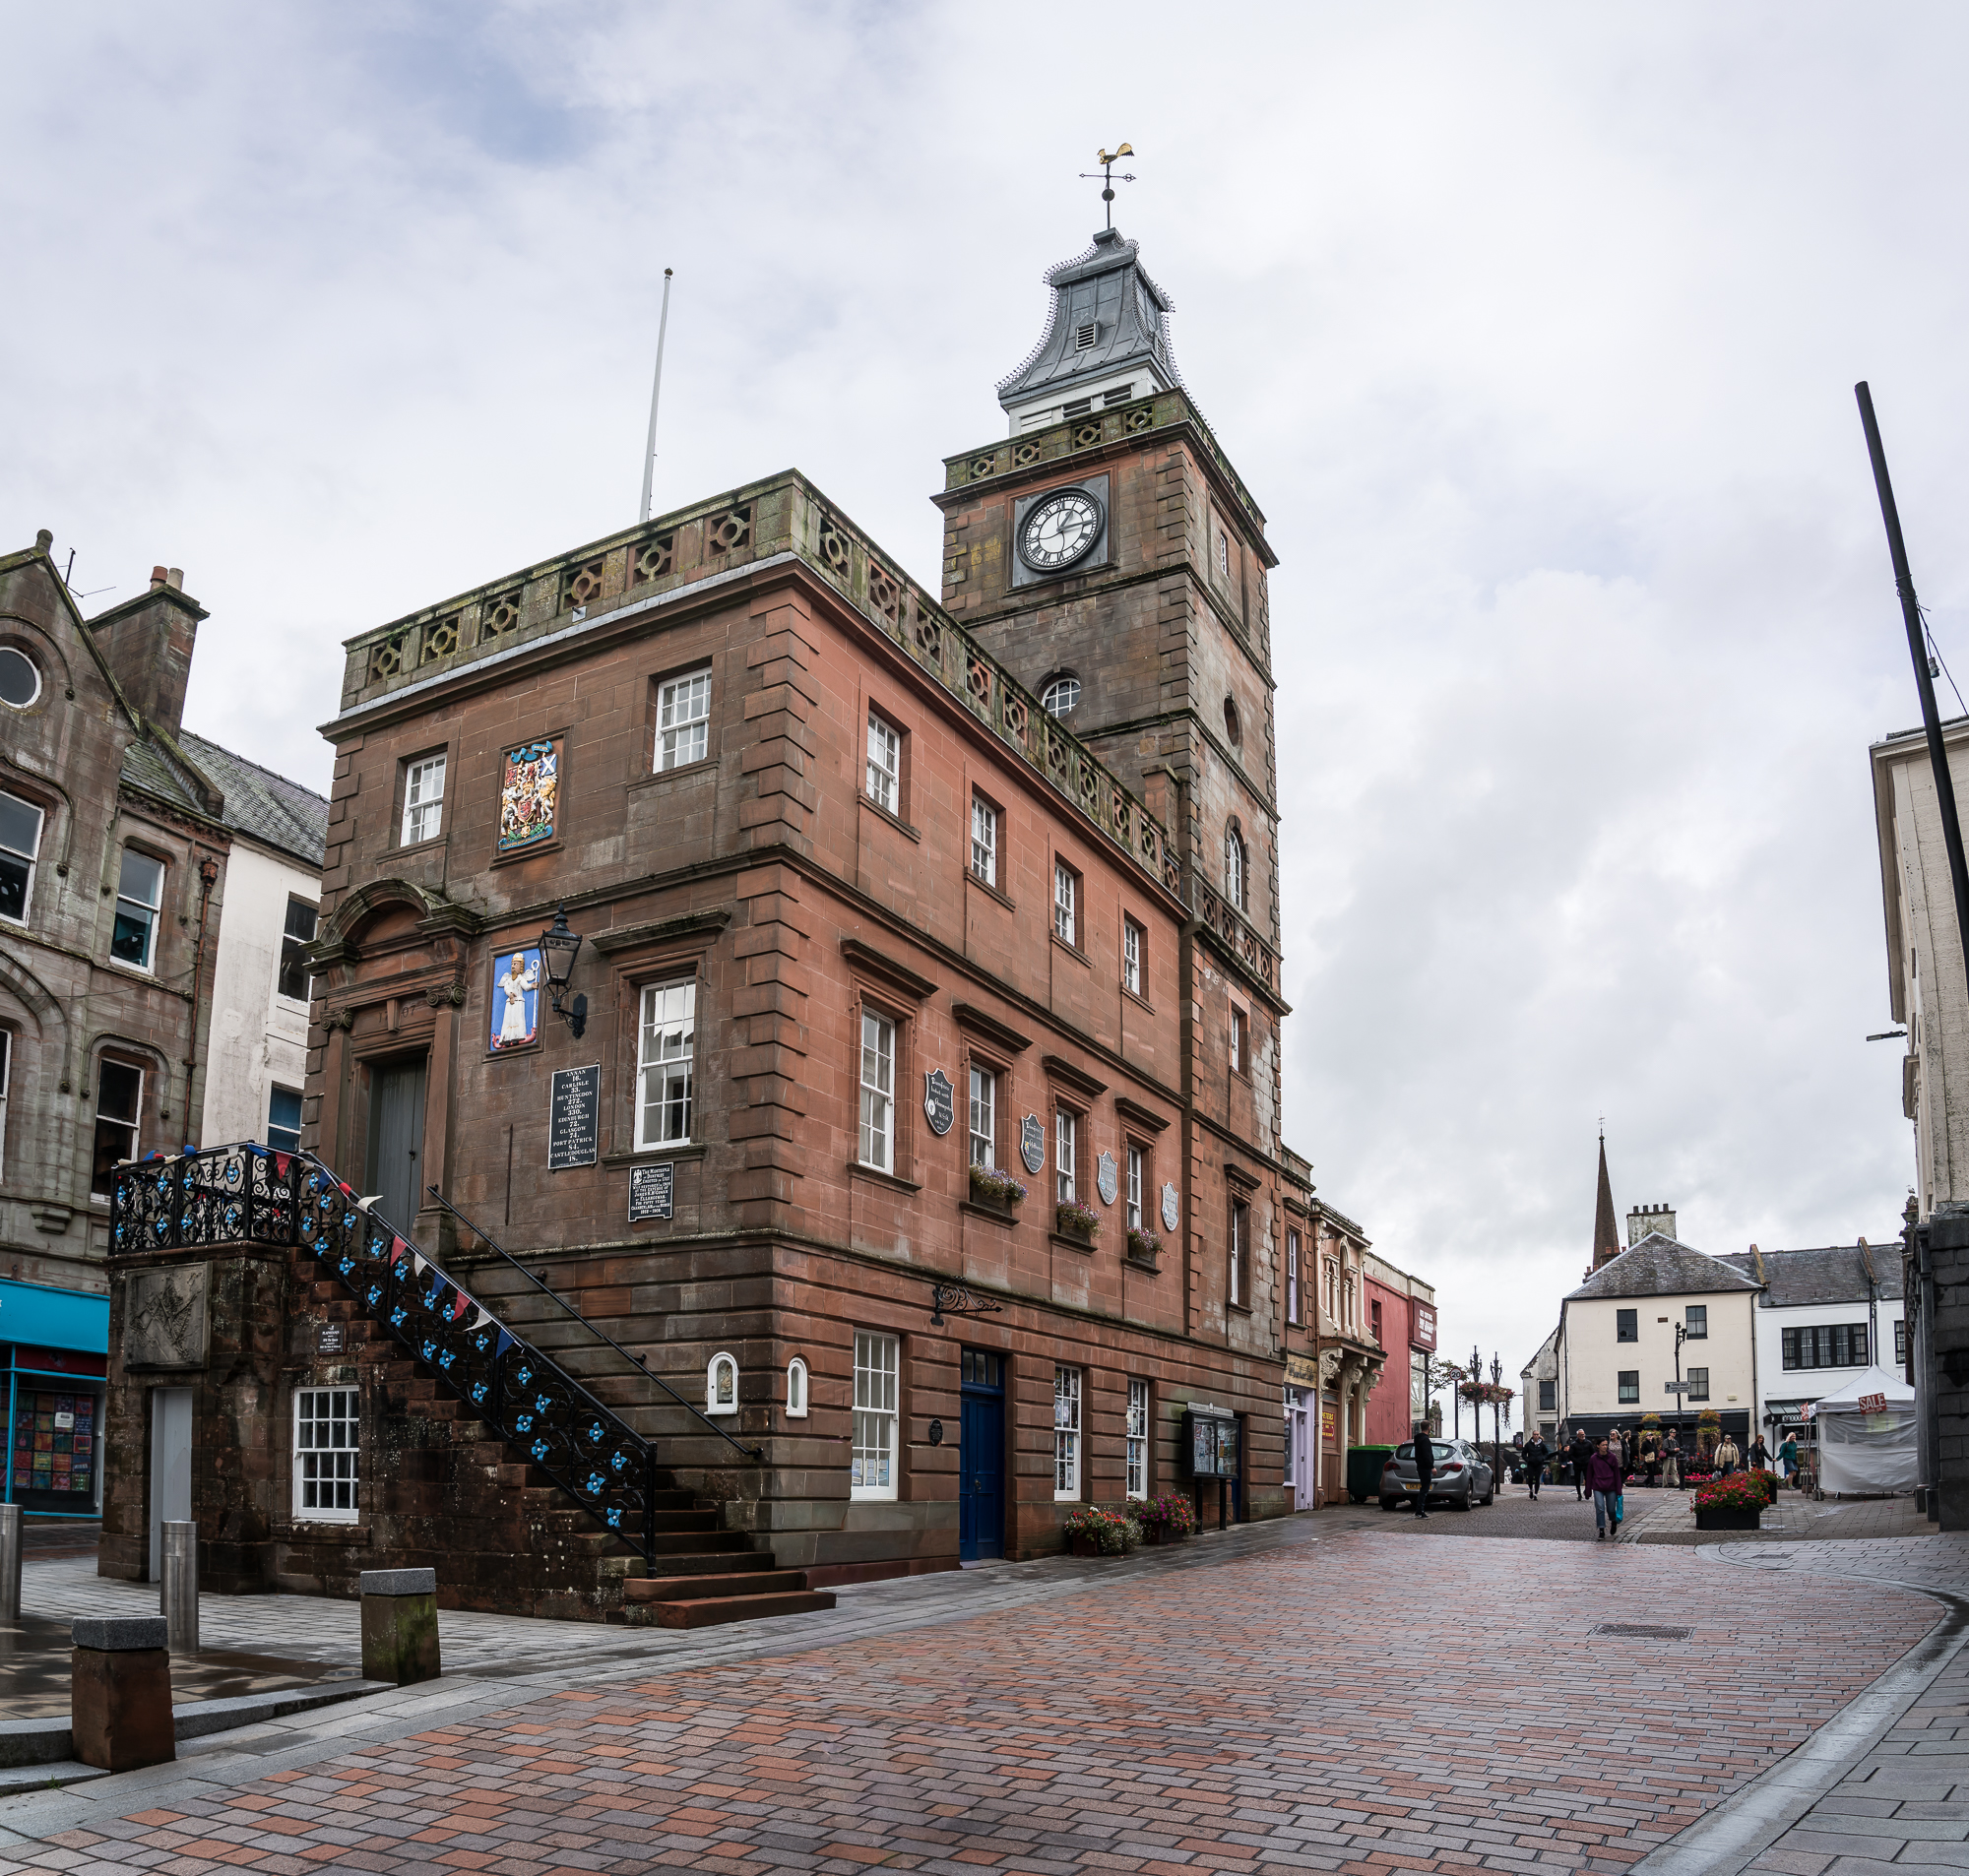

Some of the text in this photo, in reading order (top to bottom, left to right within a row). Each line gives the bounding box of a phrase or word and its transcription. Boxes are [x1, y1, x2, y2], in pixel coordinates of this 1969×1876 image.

[561, 1080, 589, 1089] CARLISLE
[557, 1091, 593, 1101] HUNTINGDON
[563, 1102, 585, 1111] LONDON
[557, 1113, 590, 1123] EDINBURGH
[559, 1125, 587, 1135] GLASGOW
[550, 1147, 596, 1158] CASTLEDOUGLAS
[1859, 1393, 1885, 1410] SALE
